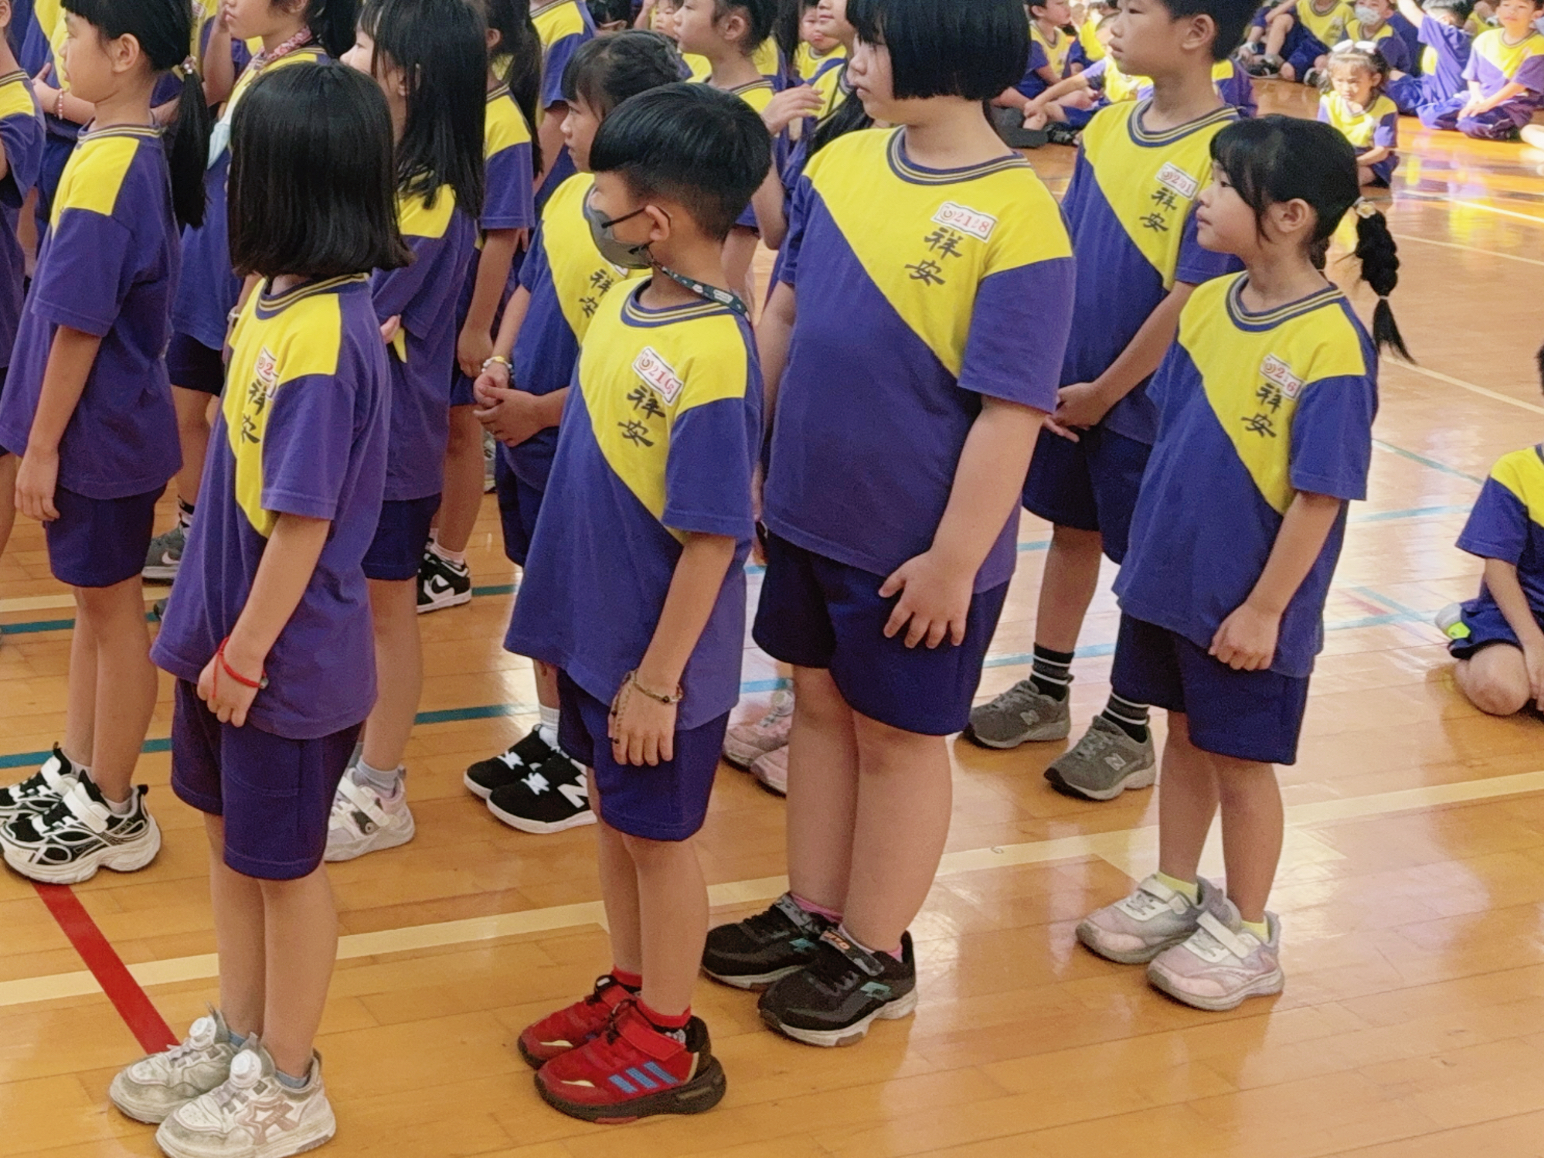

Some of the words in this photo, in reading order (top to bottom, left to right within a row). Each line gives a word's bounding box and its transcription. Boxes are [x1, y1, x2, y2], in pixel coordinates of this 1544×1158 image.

[1139, 187, 1178, 233] 祥安
[904, 226, 964, 287] 祥安
[617, 385, 666, 448] 祥安
[1241, 382, 1282, 438] 祥安
